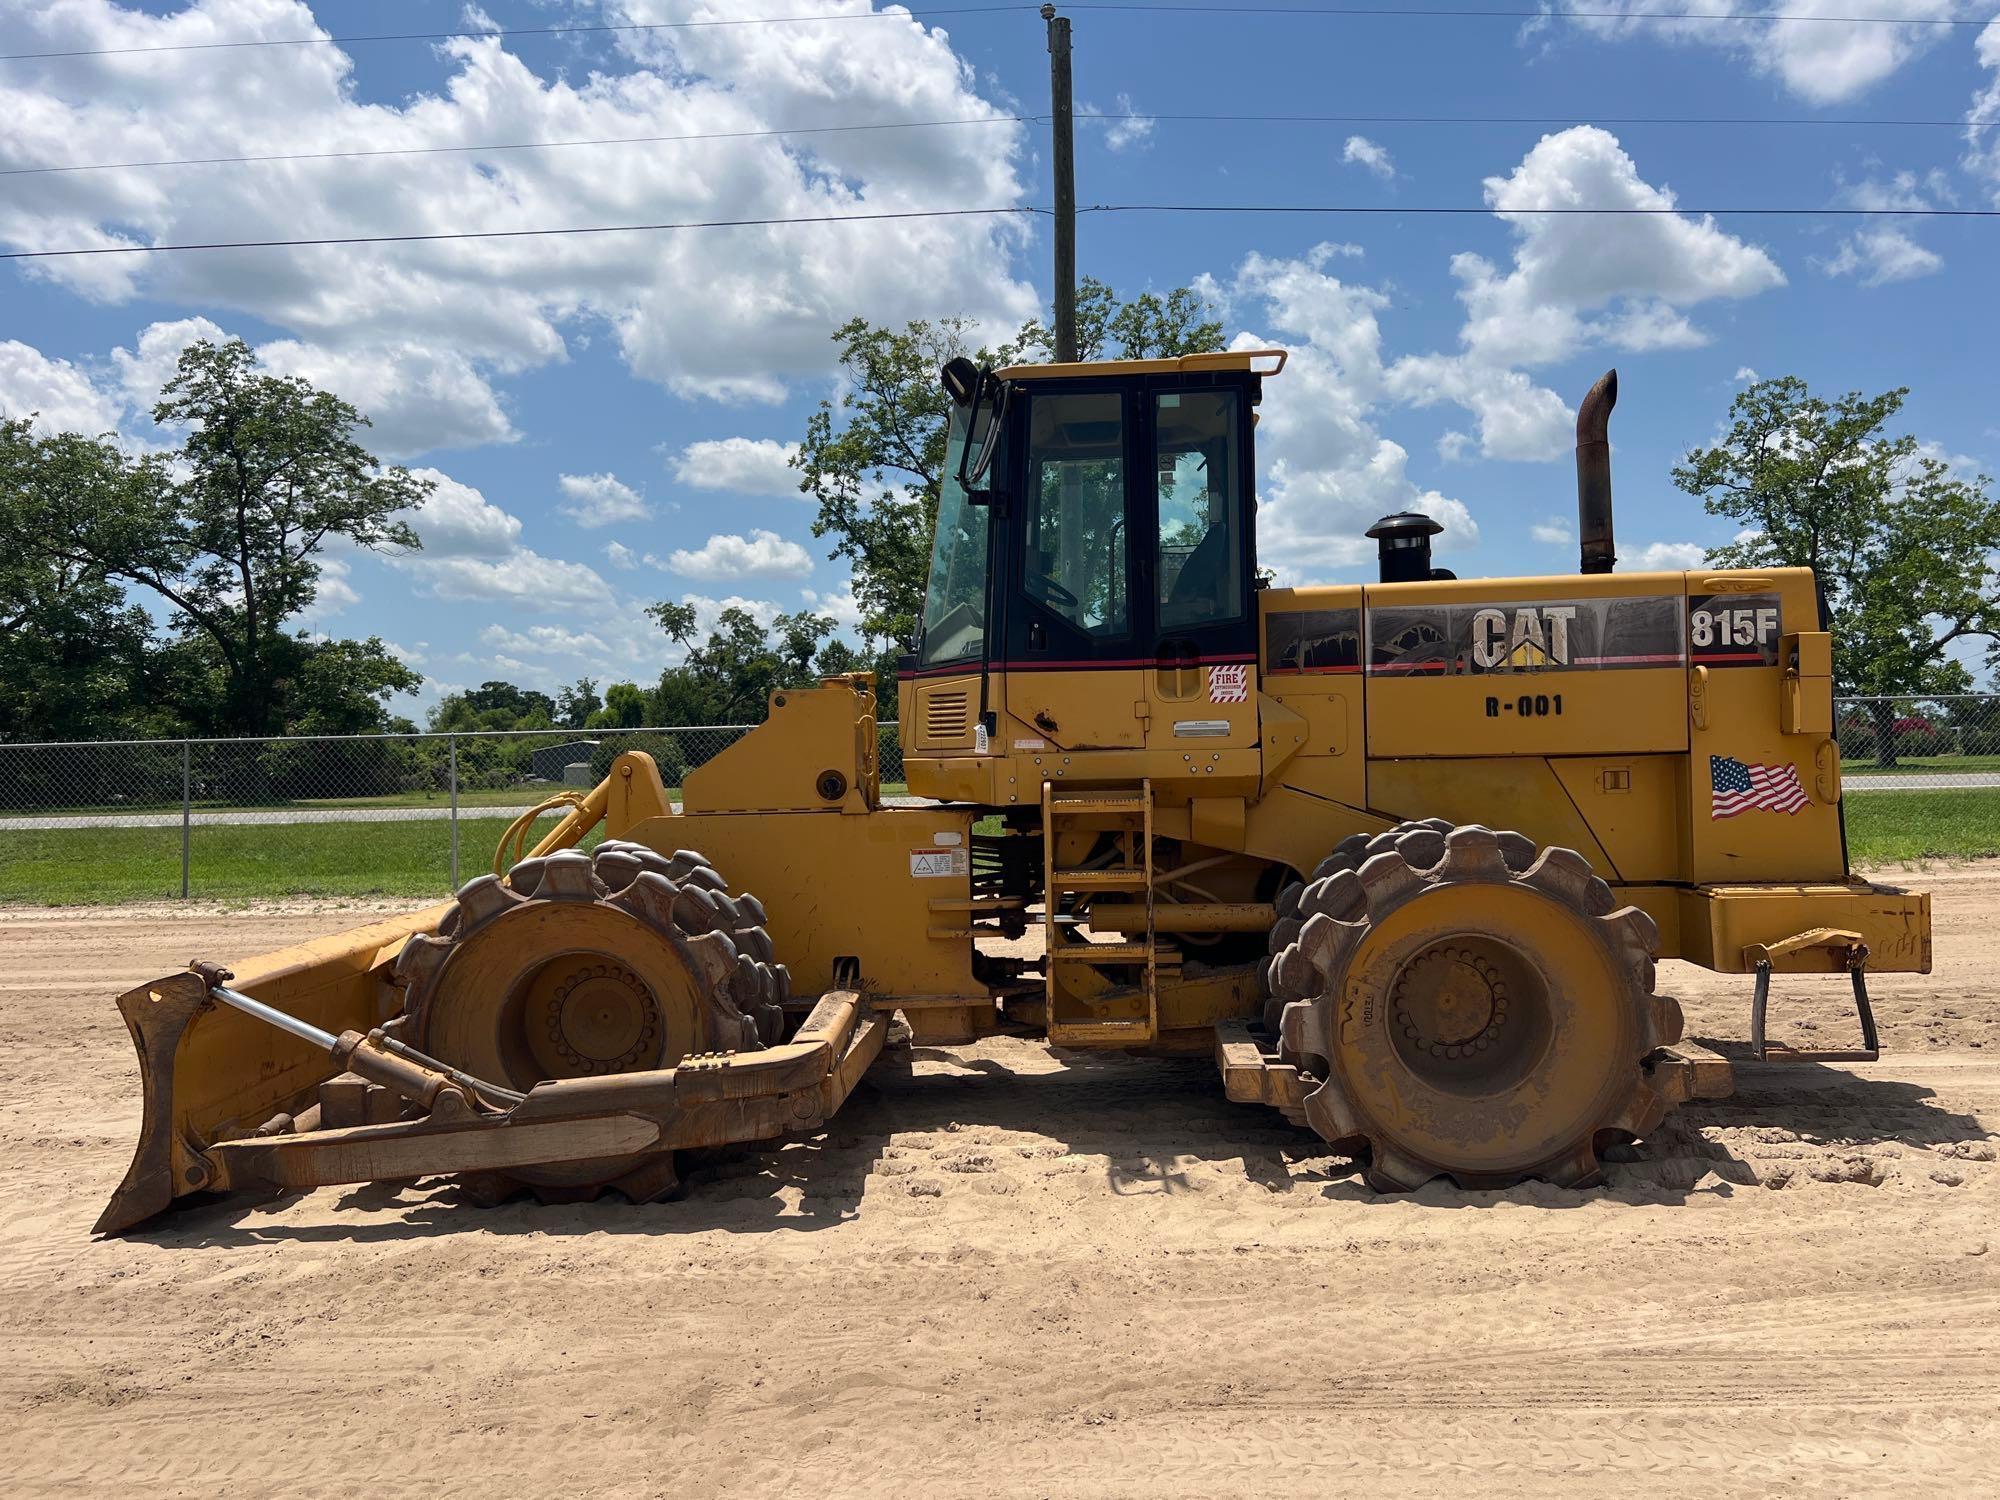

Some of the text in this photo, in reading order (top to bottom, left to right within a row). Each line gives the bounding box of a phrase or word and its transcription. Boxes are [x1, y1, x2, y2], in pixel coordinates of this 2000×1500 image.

[1473, 606, 1576, 668] CAT
[1691, 608, 1777, 647] 815F
[1215, 673, 1239, 684] FIRE
[1486, 694, 1562, 717] R-001
